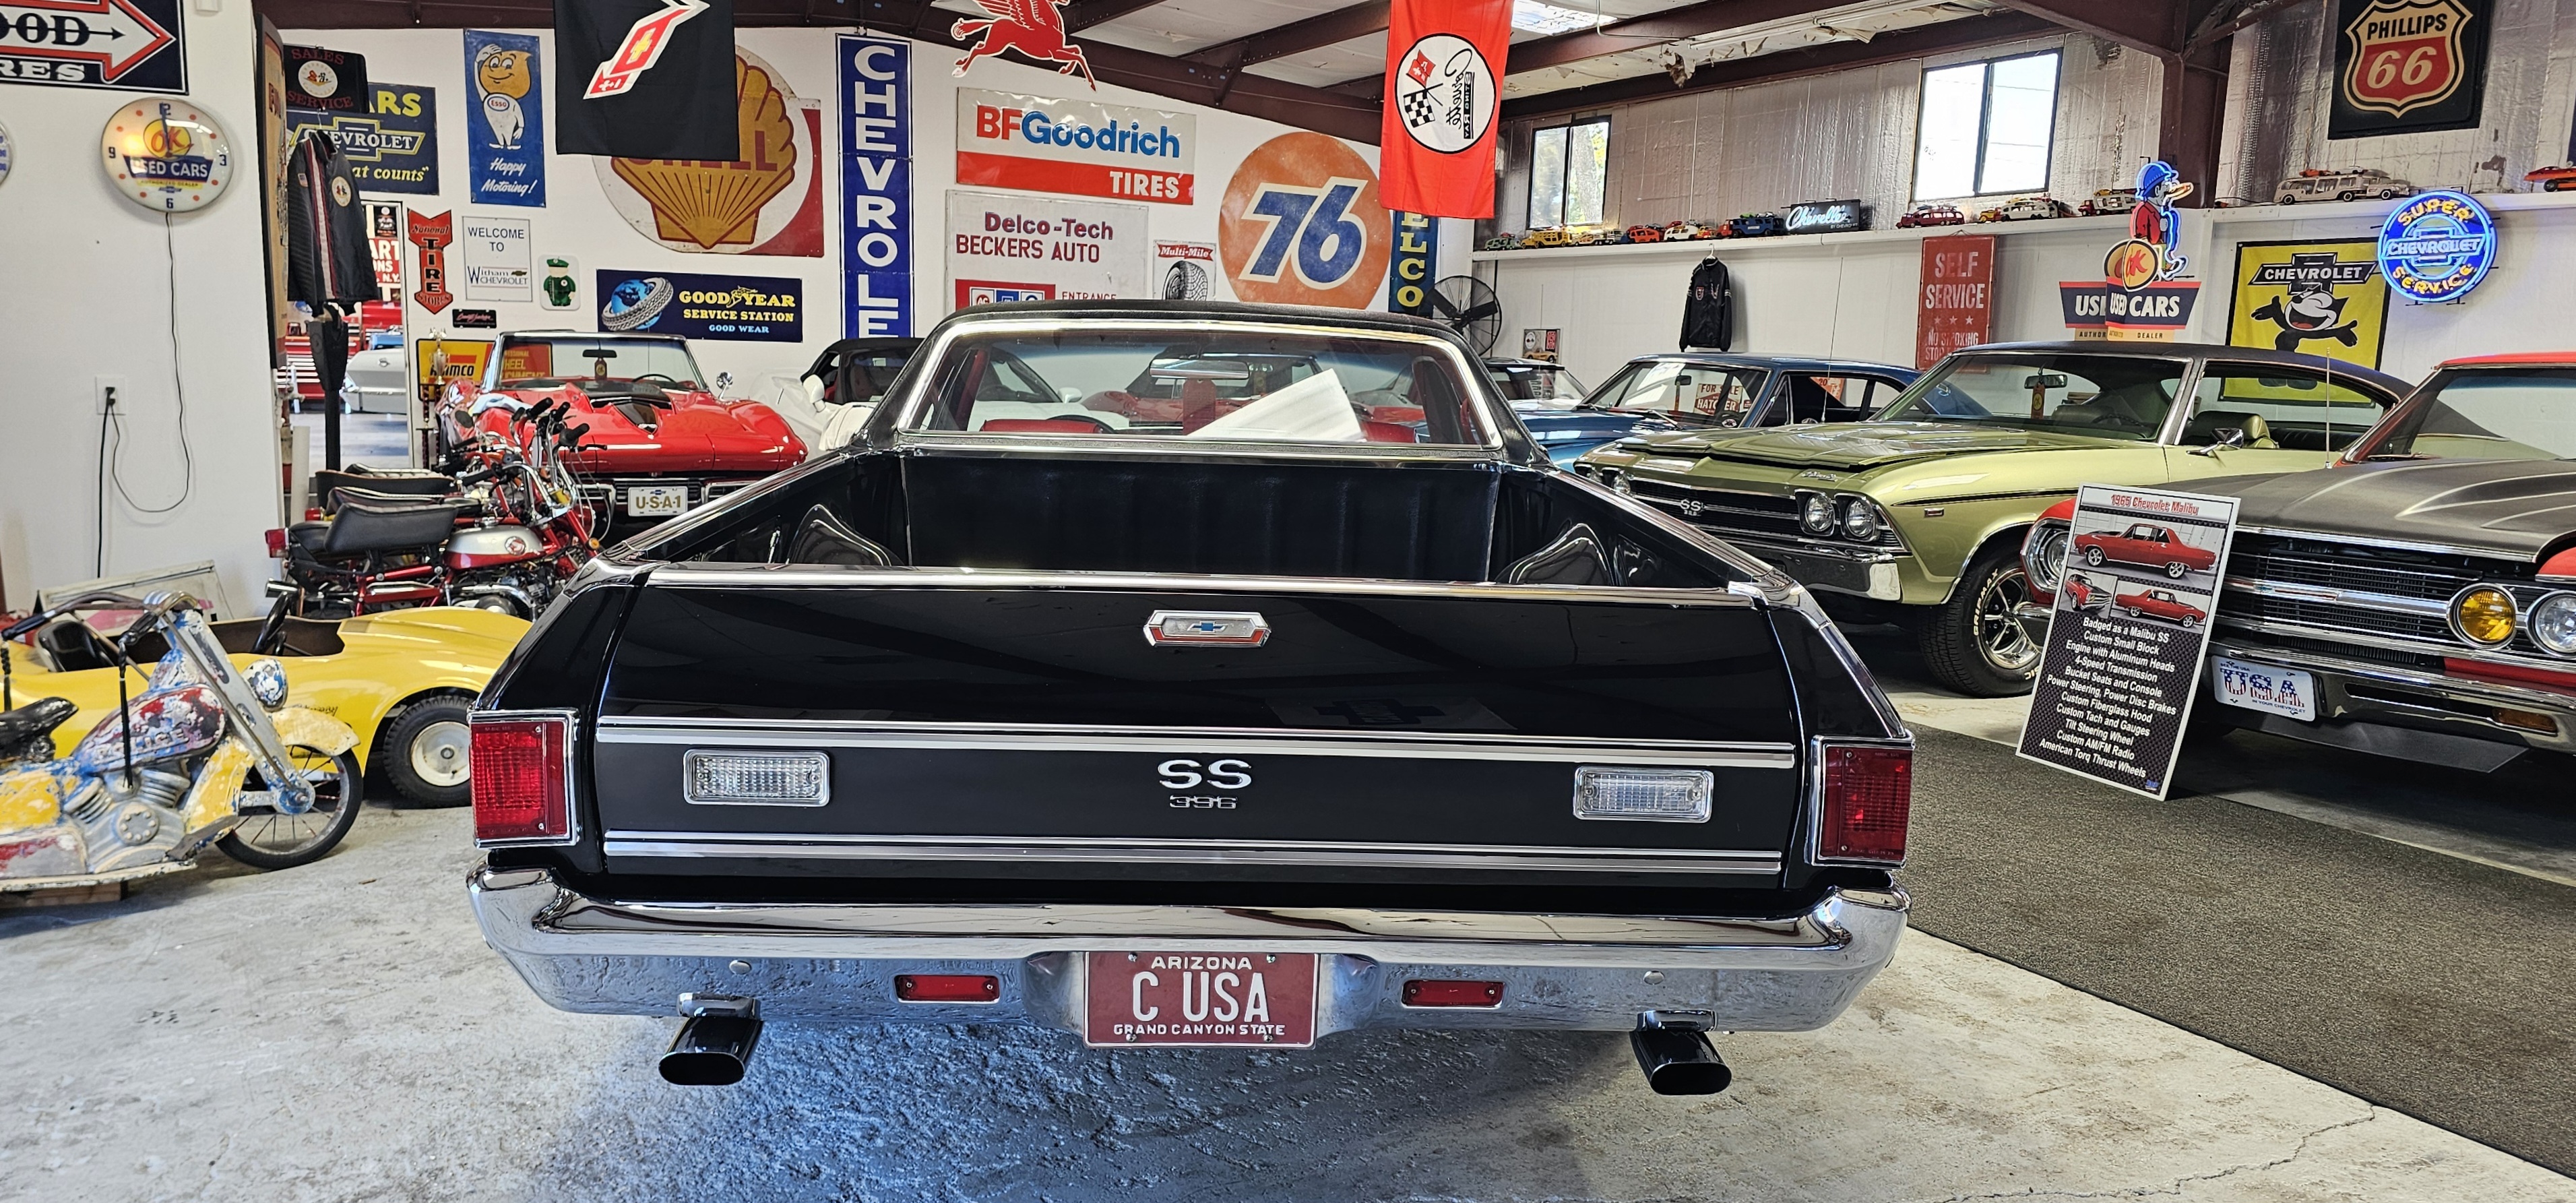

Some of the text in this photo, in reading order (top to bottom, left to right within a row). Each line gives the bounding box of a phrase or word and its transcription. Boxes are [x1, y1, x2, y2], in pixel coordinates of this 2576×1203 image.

[0, 13, 90, 46] OD
[2367, 13, 2447, 40] PHILLIPS
[291, 49, 344, 65] SALES
[2367, 46, 2437, 89] 66
[287, 91, 354, 109] SERVICE
[370, 90, 422, 117] RS
[152, 127, 186, 152] OK
[977, 104, 1180, 158] BFGoodrich
[108, 147, 116, 158] 9
[219, 154, 227, 166] 3
[132, 159, 208, 178] SED CARS
[490, 157, 526, 177] Happy
[481, 179, 538, 197] Motoring!
[1110, 171, 1179, 198] TIRES
[166, 197, 174, 209] 6
[2397, 199, 2476, 226] SUPER
[412, 223, 449, 235] National
[985, 211, 1113, 240] Delco-Tech
[1786, 205, 1851, 230] Chevelle
[468, 226, 524, 239] WELCOME
[1241, 177, 1368, 290] 76
[489, 242, 505, 252] TO
[956, 234, 1100, 263] BECKERS AUTO
[1160, 247, 1210, 259] Multi-Mile
[2387, 238, 2480, 256] CHEVROLET
[422, 237, 442, 294] TIRE
[1935, 251, 1978, 278] SELF
[2264, 266, 2362, 280] CHEVROLET
[480, 276, 528, 285] CHEVROLET
[2393, 265, 2477, 294] SERVICE
[416, 292, 450, 306] STORES
[1925, 283, 1985, 309] SERVICE
[2110, 292, 2180, 317] USED CARS
[683, 309, 794, 322] SERVICE STATION
[709, 324, 735, 332] GOOD
[1928, 331, 1939, 346] NO
[1701, 385, 1739, 395] FOR SLE
[1697, 398, 1736, 411] HATCER
[1680, 498, 1701, 512] SS
[2133, 497, 2170, 512] Chevrolet
[2171, 501, 2199, 516] Malibu
[2083, 617, 2112, 631] Badged
[2112, 625, 2122, 633] as
[2130, 627, 2156, 640] Malibu
[2158, 631, 2169, 643] SS
[2083, 631, 2160, 655] Custom Small Block
[2066, 640, 2175, 673] Engine with Aluminum Heads
[2075, 655, 2158, 683] 4-Speed Transmission
[2047, 674, 2176, 715] Power Steering, Power Disc Brakes
[2065, 666, 2162, 698] Bucket Seats and Console
[2220, 668, 2304, 708] USA
[2061, 691, 2153, 723] Custom Fiberglass Hood
[2274, 703, 2306, 714] CHEVROLET
[2056, 703, 2150, 737] Custom Tach and Gauges
[2065, 718, 2134, 746] Tilt Steering Wheel
[2056, 730, 2135, 760] Custom AM/FM Radio
[2040, 739, 2146, 778] American Torq Thrust Wheels
[1157, 759, 1252, 789] SS
[1169, 795, 1238, 809] 396
[1151, 956, 1252, 970] ARIZONA
[1133, 971, 1269, 1022] C USA
[1113, 1024, 1286, 1035] GRAND CANYON STATE
